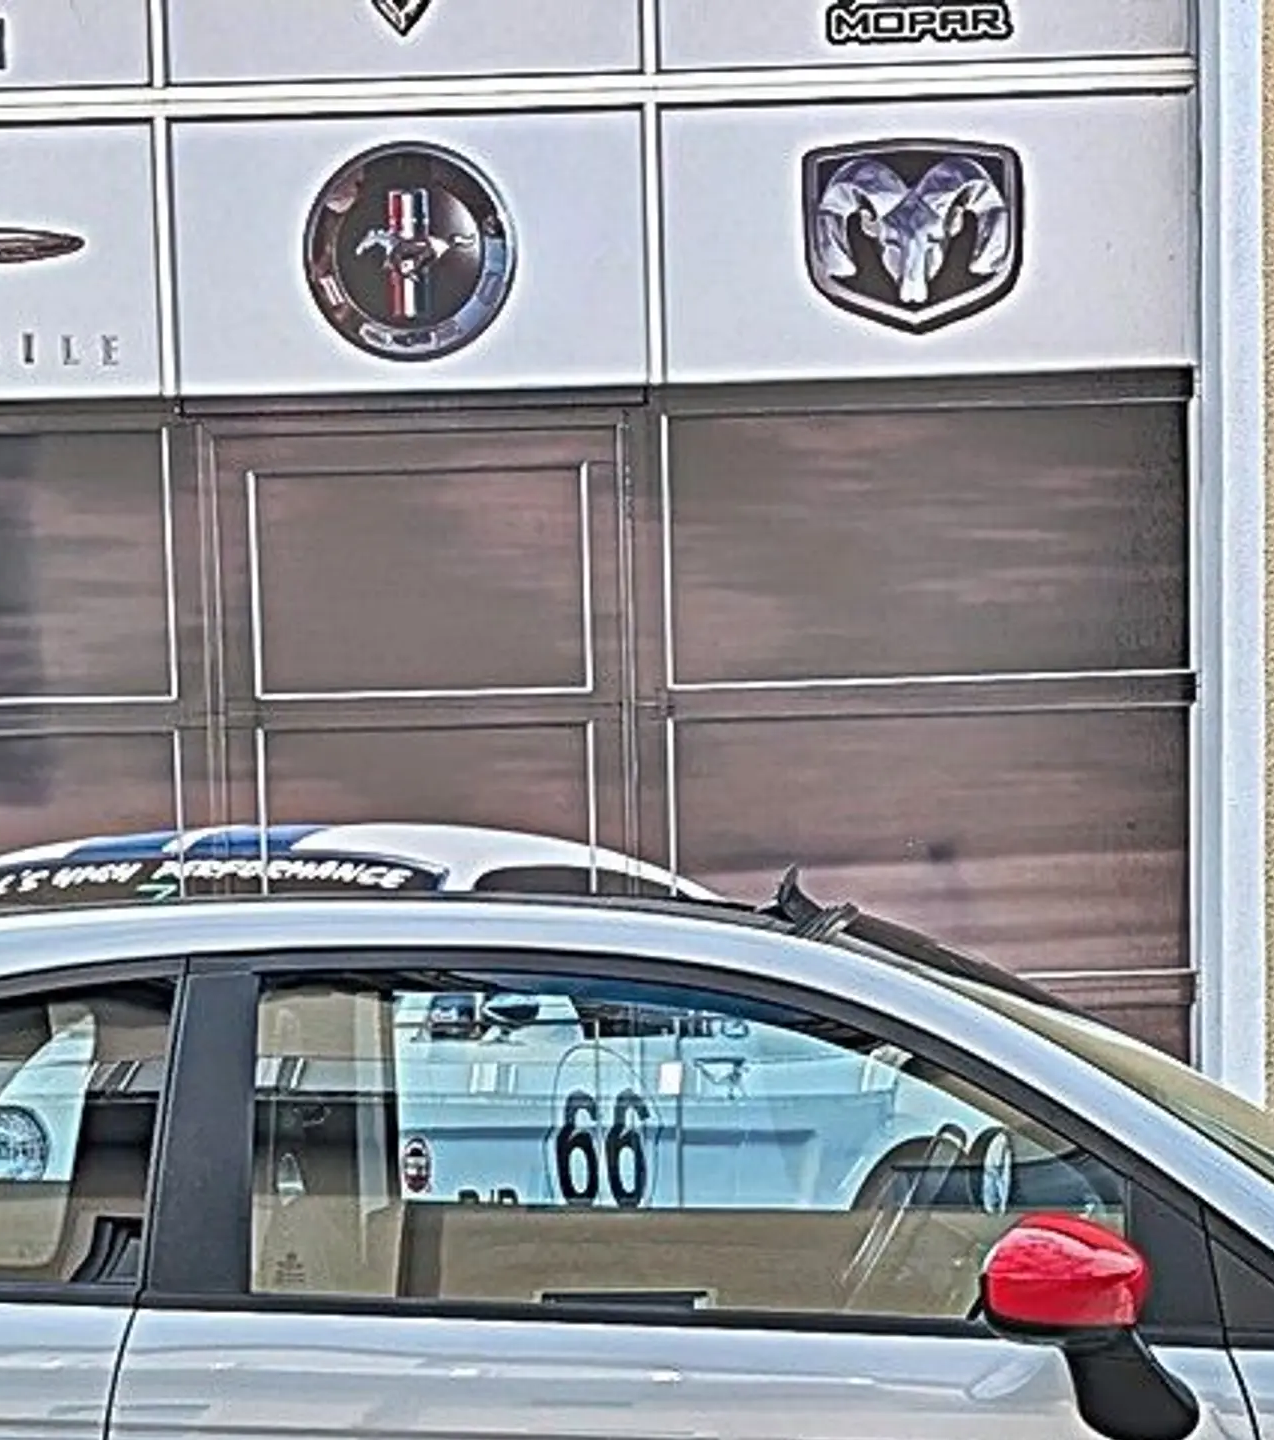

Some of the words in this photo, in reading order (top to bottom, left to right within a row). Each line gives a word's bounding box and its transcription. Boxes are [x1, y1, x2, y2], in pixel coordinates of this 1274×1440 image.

[830, 6, 1010, 41] MOPAR
[150, 858, 415, 889] PERFORMANCE
[556, 1088, 650, 1206] 66
